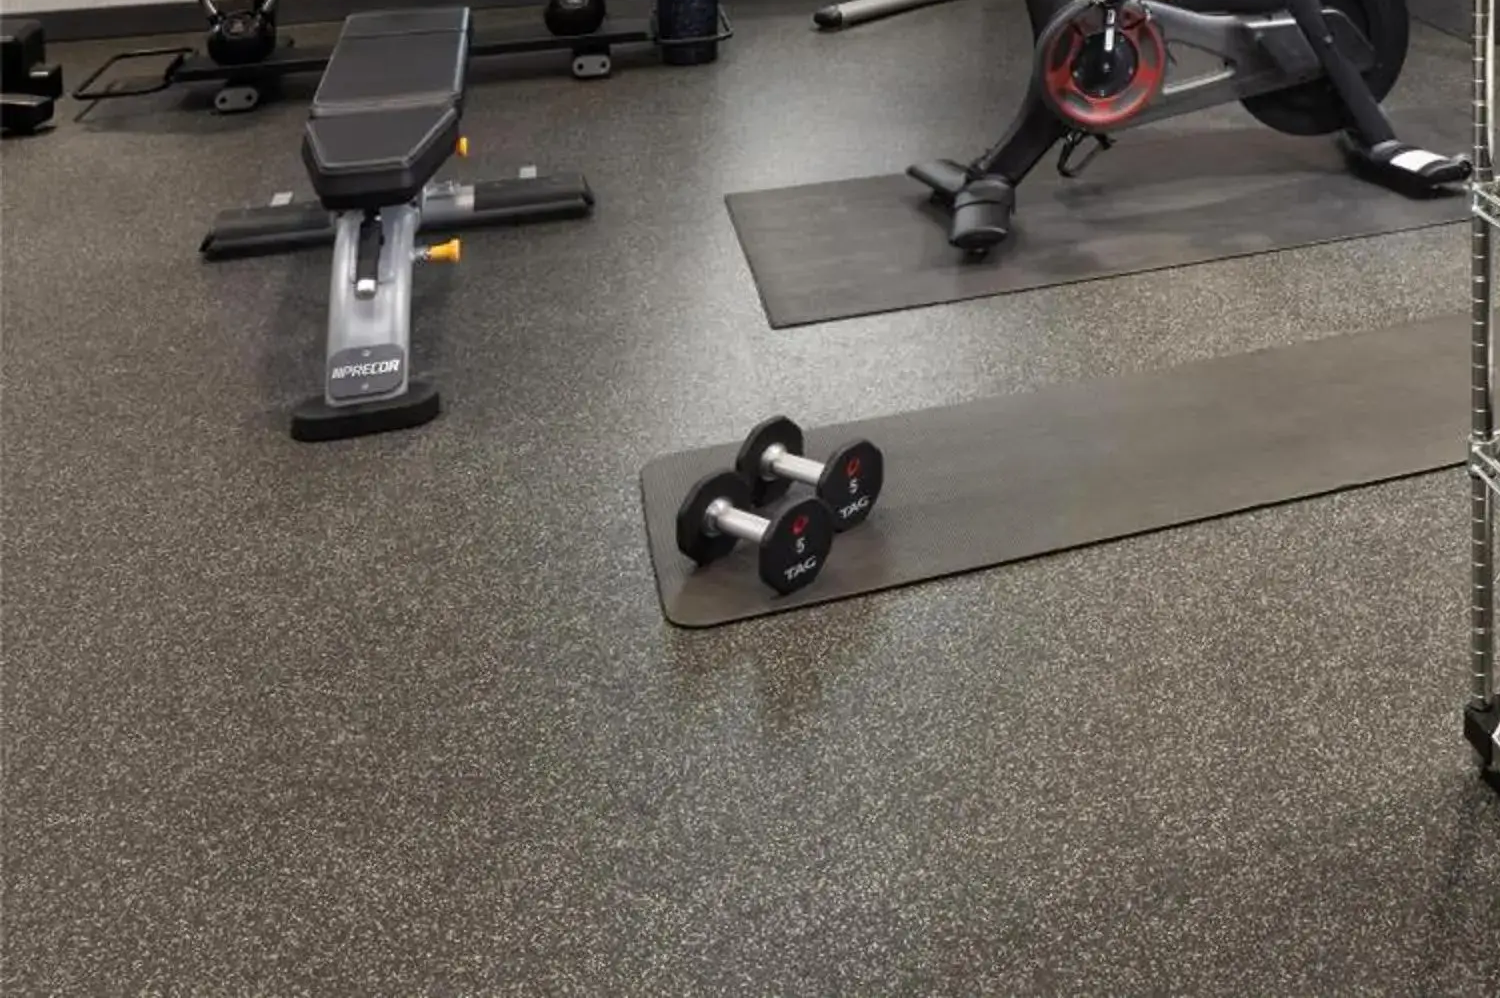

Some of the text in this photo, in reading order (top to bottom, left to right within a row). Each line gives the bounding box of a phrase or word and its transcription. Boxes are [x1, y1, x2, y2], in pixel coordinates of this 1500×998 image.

[342, 358, 401, 377] PRECOR
[849, 478, 859, 494] 5
[839, 495, 870, 519] TAG
[795, 537, 806, 553] 5
[784, 555, 817, 581] TAG
